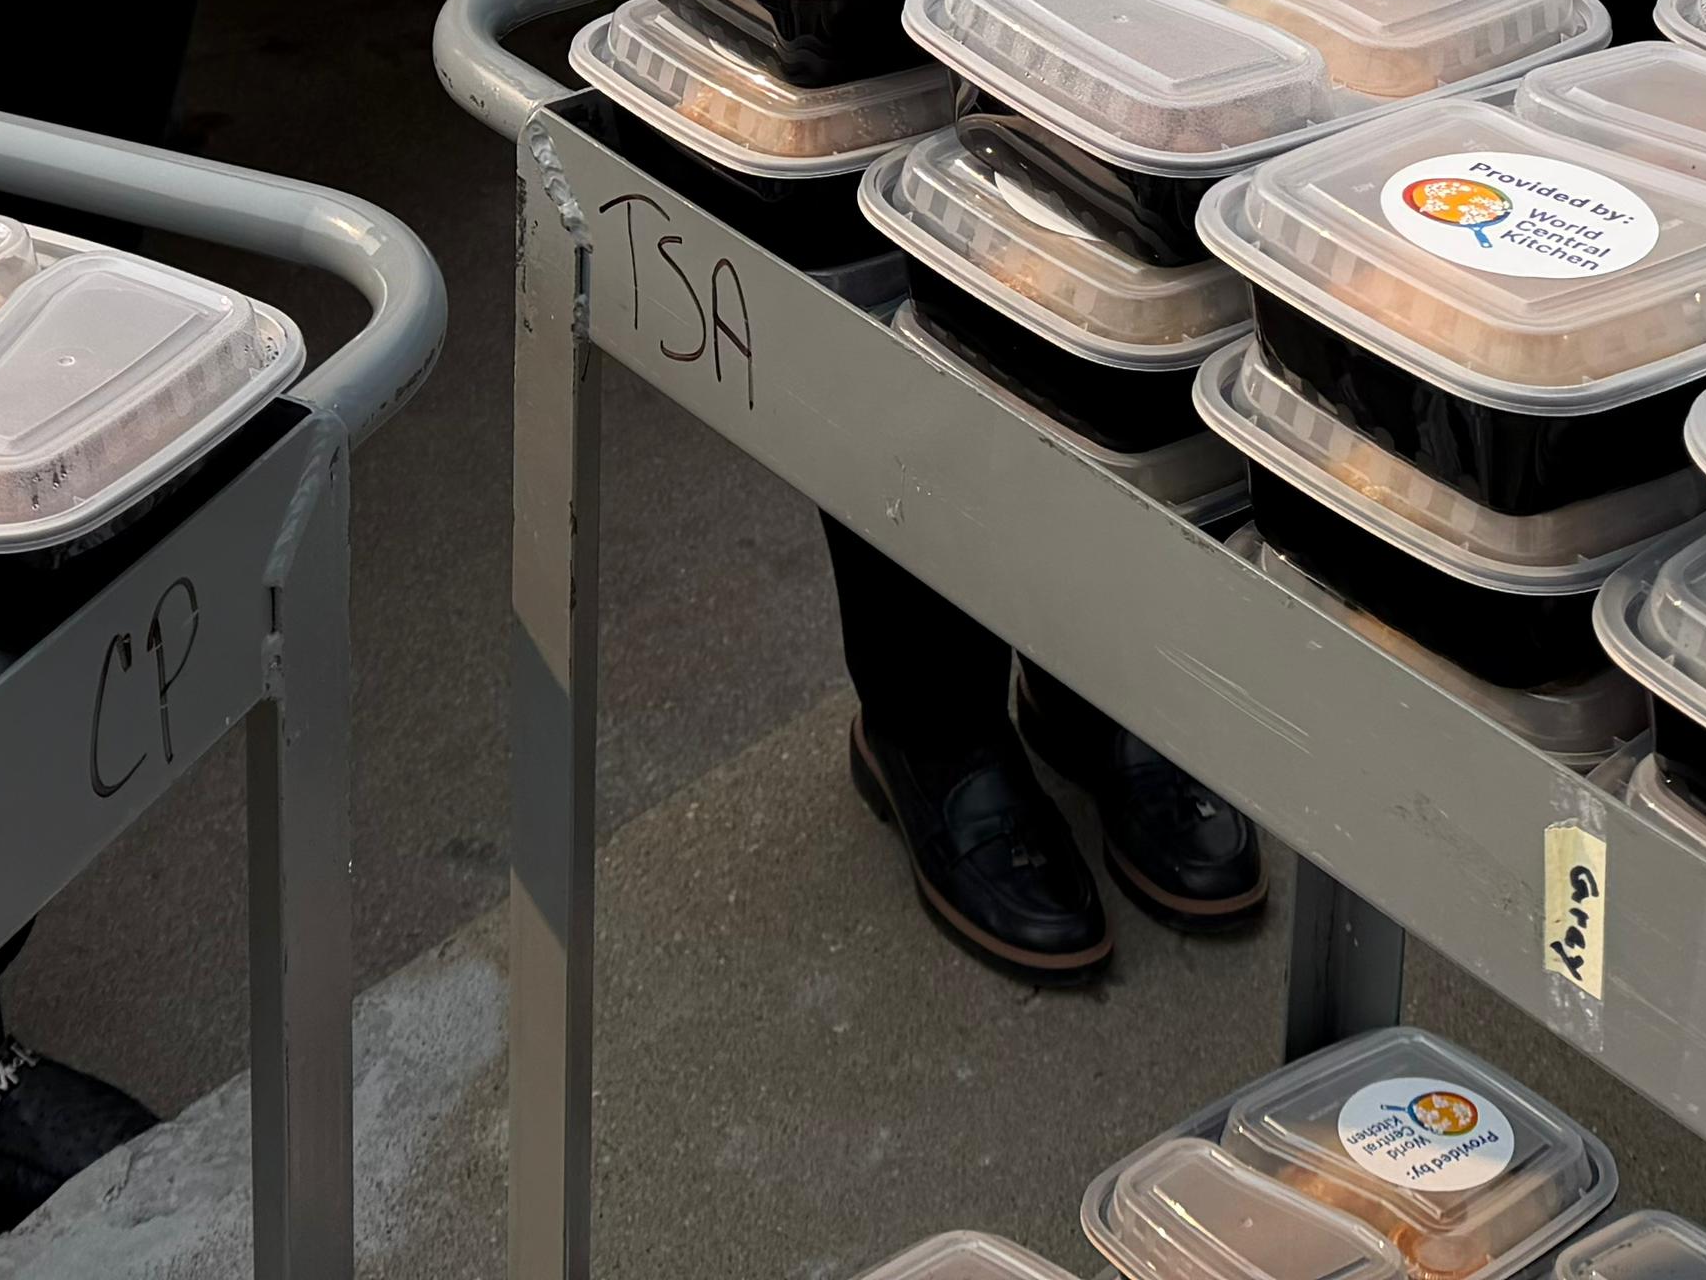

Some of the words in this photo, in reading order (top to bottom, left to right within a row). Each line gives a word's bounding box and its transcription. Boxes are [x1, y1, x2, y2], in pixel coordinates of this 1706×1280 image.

[1467, 161, 1591, 208] Provided
[1589, 203, 1634, 224] by:
[1515, 220, 1611, 258] Central
[1528, 208, 1604, 240] World
[1499, 229, 1599, 271] Kitchen
[599, 194, 754, 410] TSA
[90, 576, 199, 798] CP
[1345, 1114, 1403, 1144] Kitchen
[1361, 1125, 1415, 1156] Central
[1385, 1134, 1431, 1160] World
[1429, 1130, 1499, 1169] Provided
[1405, 1162, 1435, 1179] by:
